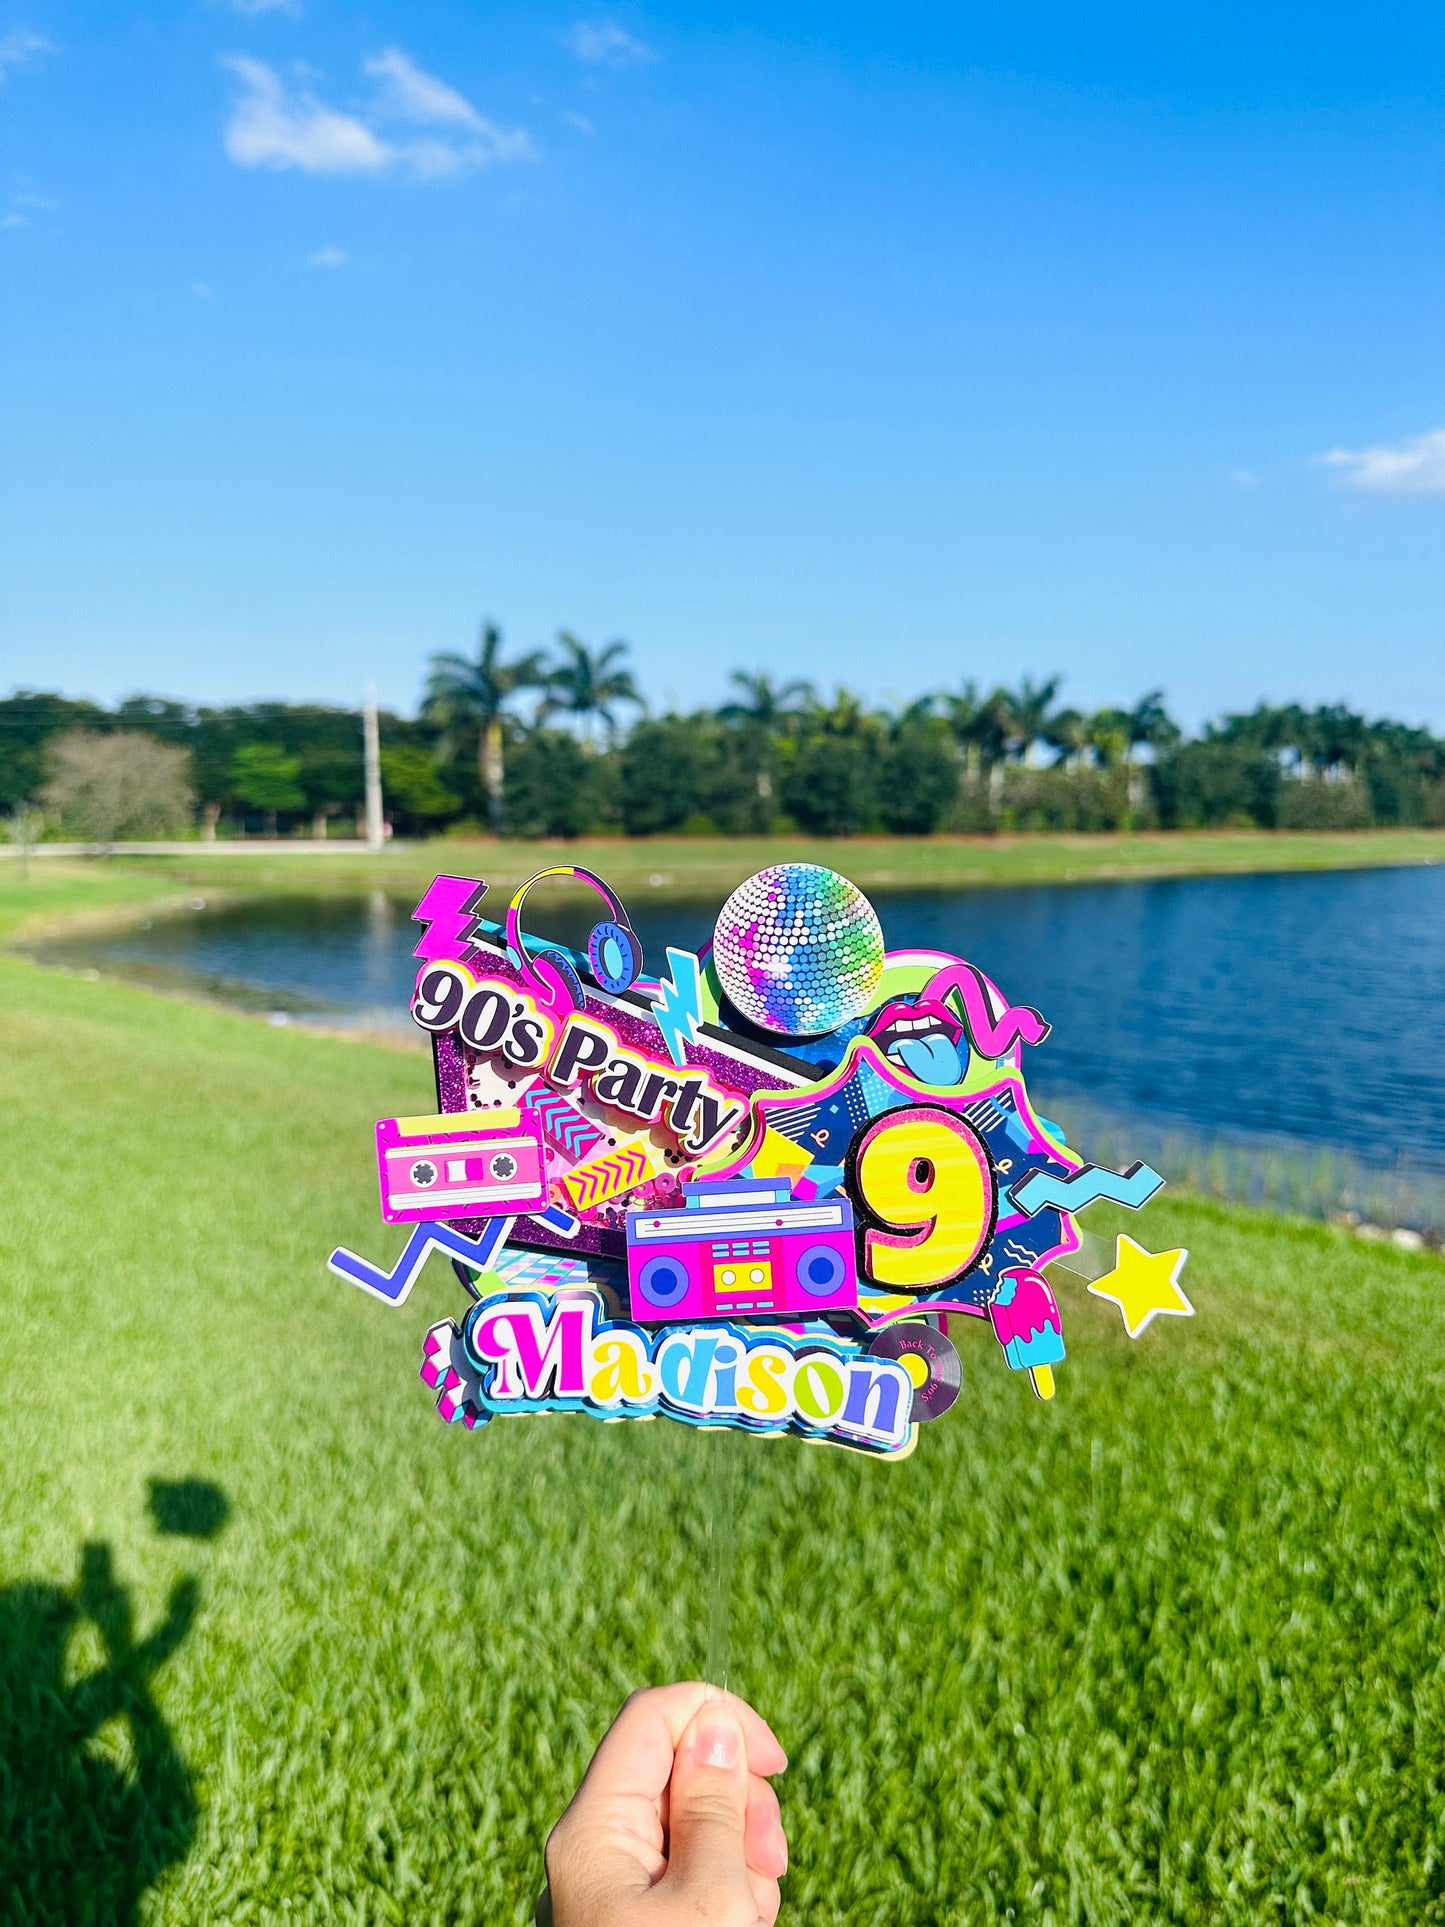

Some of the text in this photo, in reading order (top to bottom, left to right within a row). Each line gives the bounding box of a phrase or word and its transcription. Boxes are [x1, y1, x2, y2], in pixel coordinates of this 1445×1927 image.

[414, 970, 740, 1148] 90's Party
[856, 1107, 993, 1288] 9
[477, 1310, 899, 1434] Madison
[899, 1339, 924, 1350] Back
[926, 1344, 937, 1360] To
